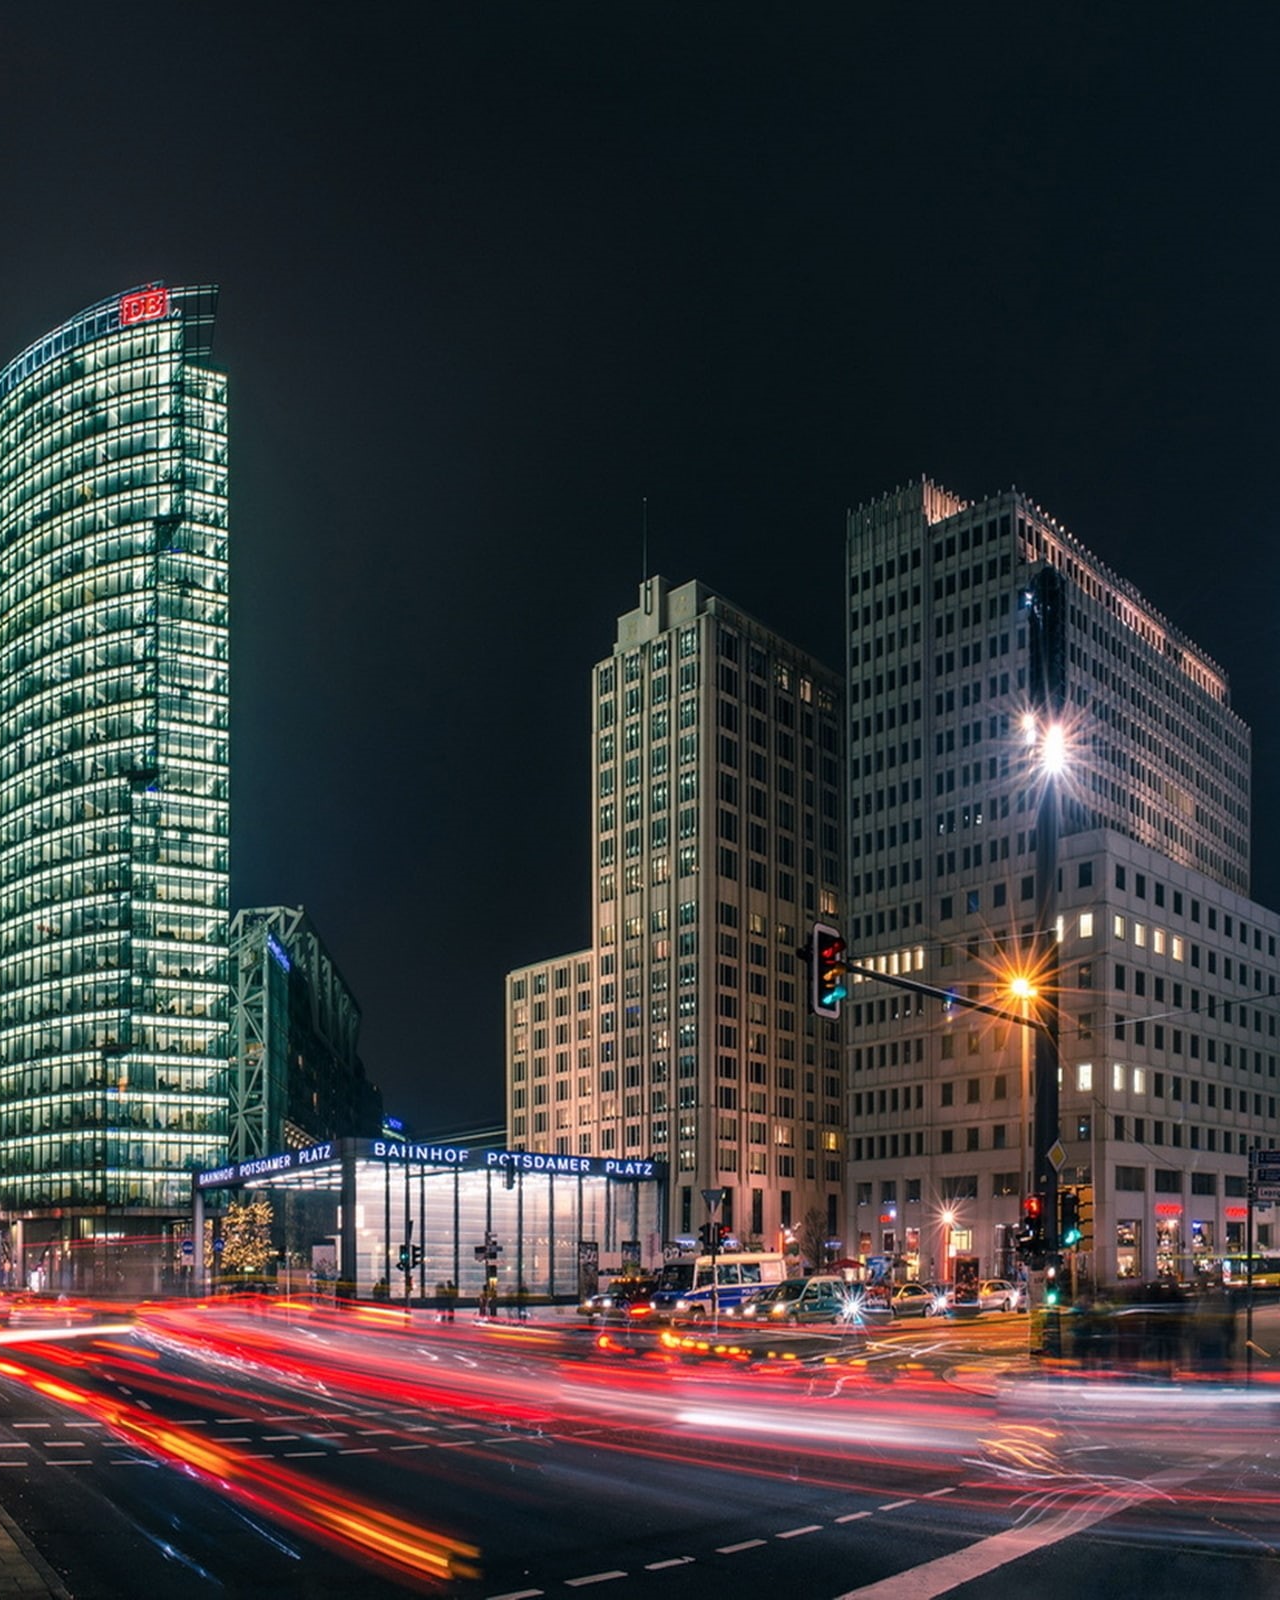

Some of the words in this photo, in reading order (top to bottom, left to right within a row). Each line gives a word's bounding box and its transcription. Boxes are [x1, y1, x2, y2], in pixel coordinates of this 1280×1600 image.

[123, 291, 166, 323] DB
[199, 1167, 234, 1185] BAHNHOF
[240, 1154, 291, 1176] POTSDAMER
[299, 1145, 331, 1164] PLATZ
[374, 1142, 469, 1162] BAHNHOF
[606, 1161, 653, 1176] PLATZ
